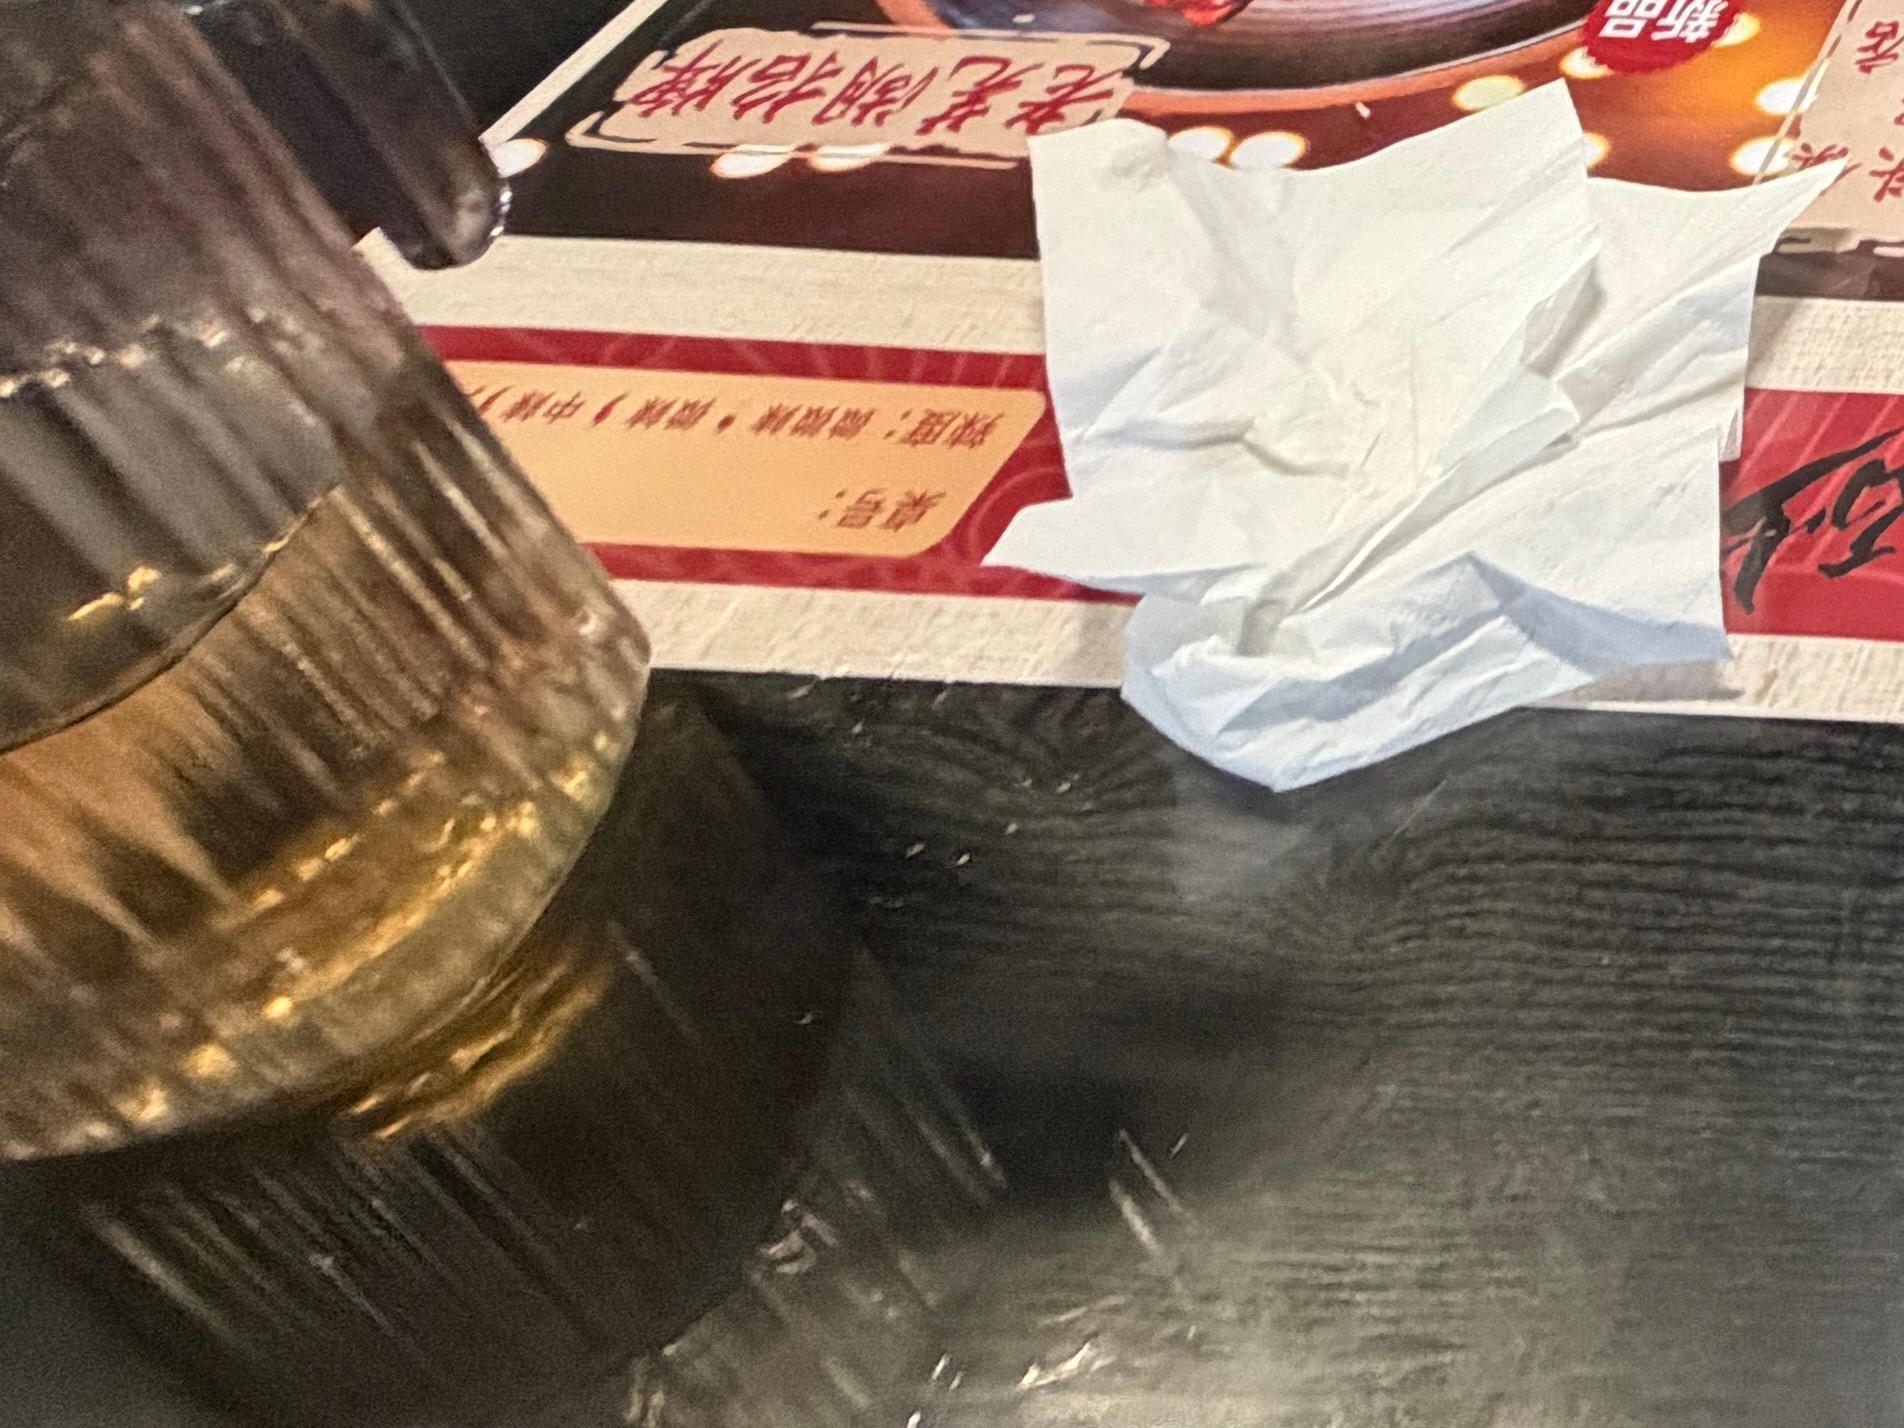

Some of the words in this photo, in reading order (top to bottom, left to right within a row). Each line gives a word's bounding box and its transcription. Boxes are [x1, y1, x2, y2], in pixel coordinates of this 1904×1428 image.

[627, 39, 1121, 136] 老芜湖招牌
